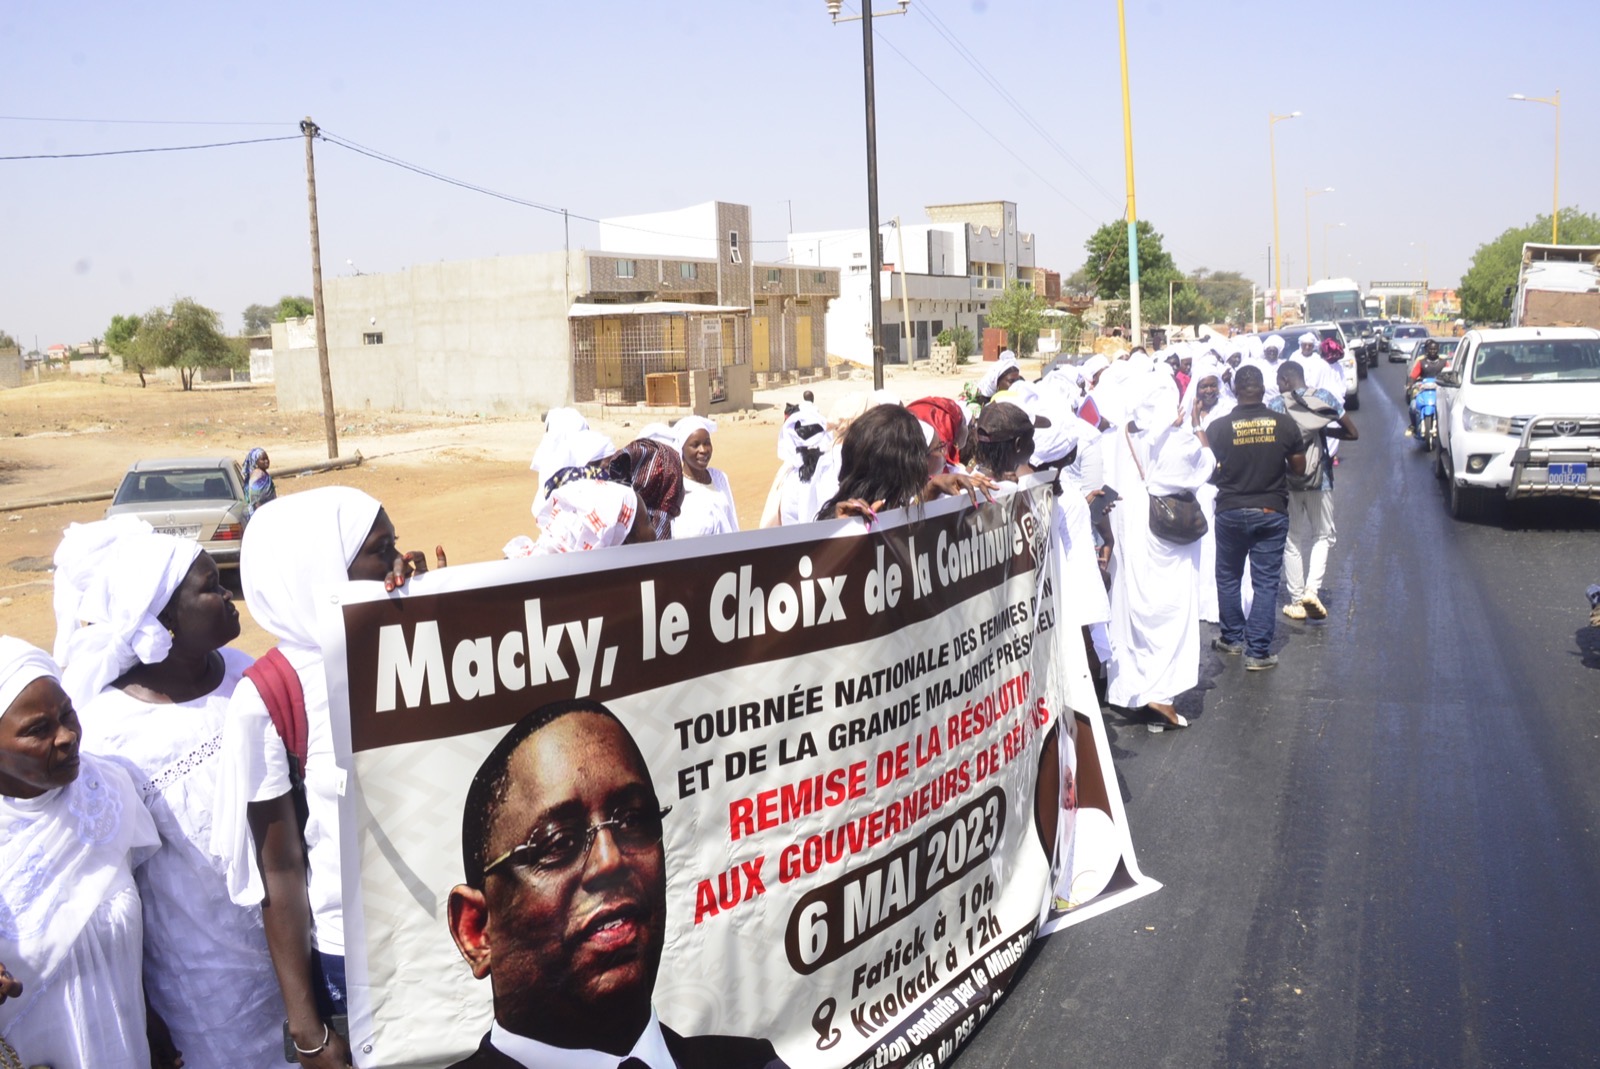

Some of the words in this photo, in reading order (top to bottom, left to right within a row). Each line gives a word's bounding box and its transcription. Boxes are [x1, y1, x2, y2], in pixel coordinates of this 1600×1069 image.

[1232, 419, 1276, 430] COMMISSION
[1236, 428, 1264, 437] DIGITALE
[1266, 427, 1275, 435] ET
[376, 598, 619, 712] Macky,
[640, 579, 690, 661] le
[709, 555, 847, 644] Choix
[864, 544, 902, 615] de
[909, 536, 932, 600] la
[674, 684, 823, 750] TOURNÉE
[835, 643, 949, 708] NATIONALE
[953, 628, 978, 662] DES
[980, 602, 1028, 645] FEMMES
[678, 759, 714, 799] ET
[725, 744, 767, 782] DE
[779, 731, 818, 766] LA
[828, 693, 920, 751] GRANDE
[926, 648, 995, 711] MAJORITÉ
[729, 761, 866, 841] REMISE
[876, 742, 909, 788] DE
[916, 725, 941, 770] LA
[694, 856, 766, 925] AUX
[778, 760, 970, 884] GOUVERNEURS
[976, 744, 999, 783] DE
[799, 900, 828, 965] 6
[844, 847, 918, 943] MAI
[926, 795, 999, 890] 2023
[850, 954, 939, 1039] Kaolack
[945, 941, 958, 972] à
[966, 908, 1002, 956] 12h
[851, 926, 925, 999] Fatick
[934, 910, 947, 941] à
[959, 874, 994, 924] 10h
[906, 996, 959, 1046] conduite
[952, 977, 976, 1009] par
[971, 967, 988, 988] le
[937, 1039, 953, 1064] du
